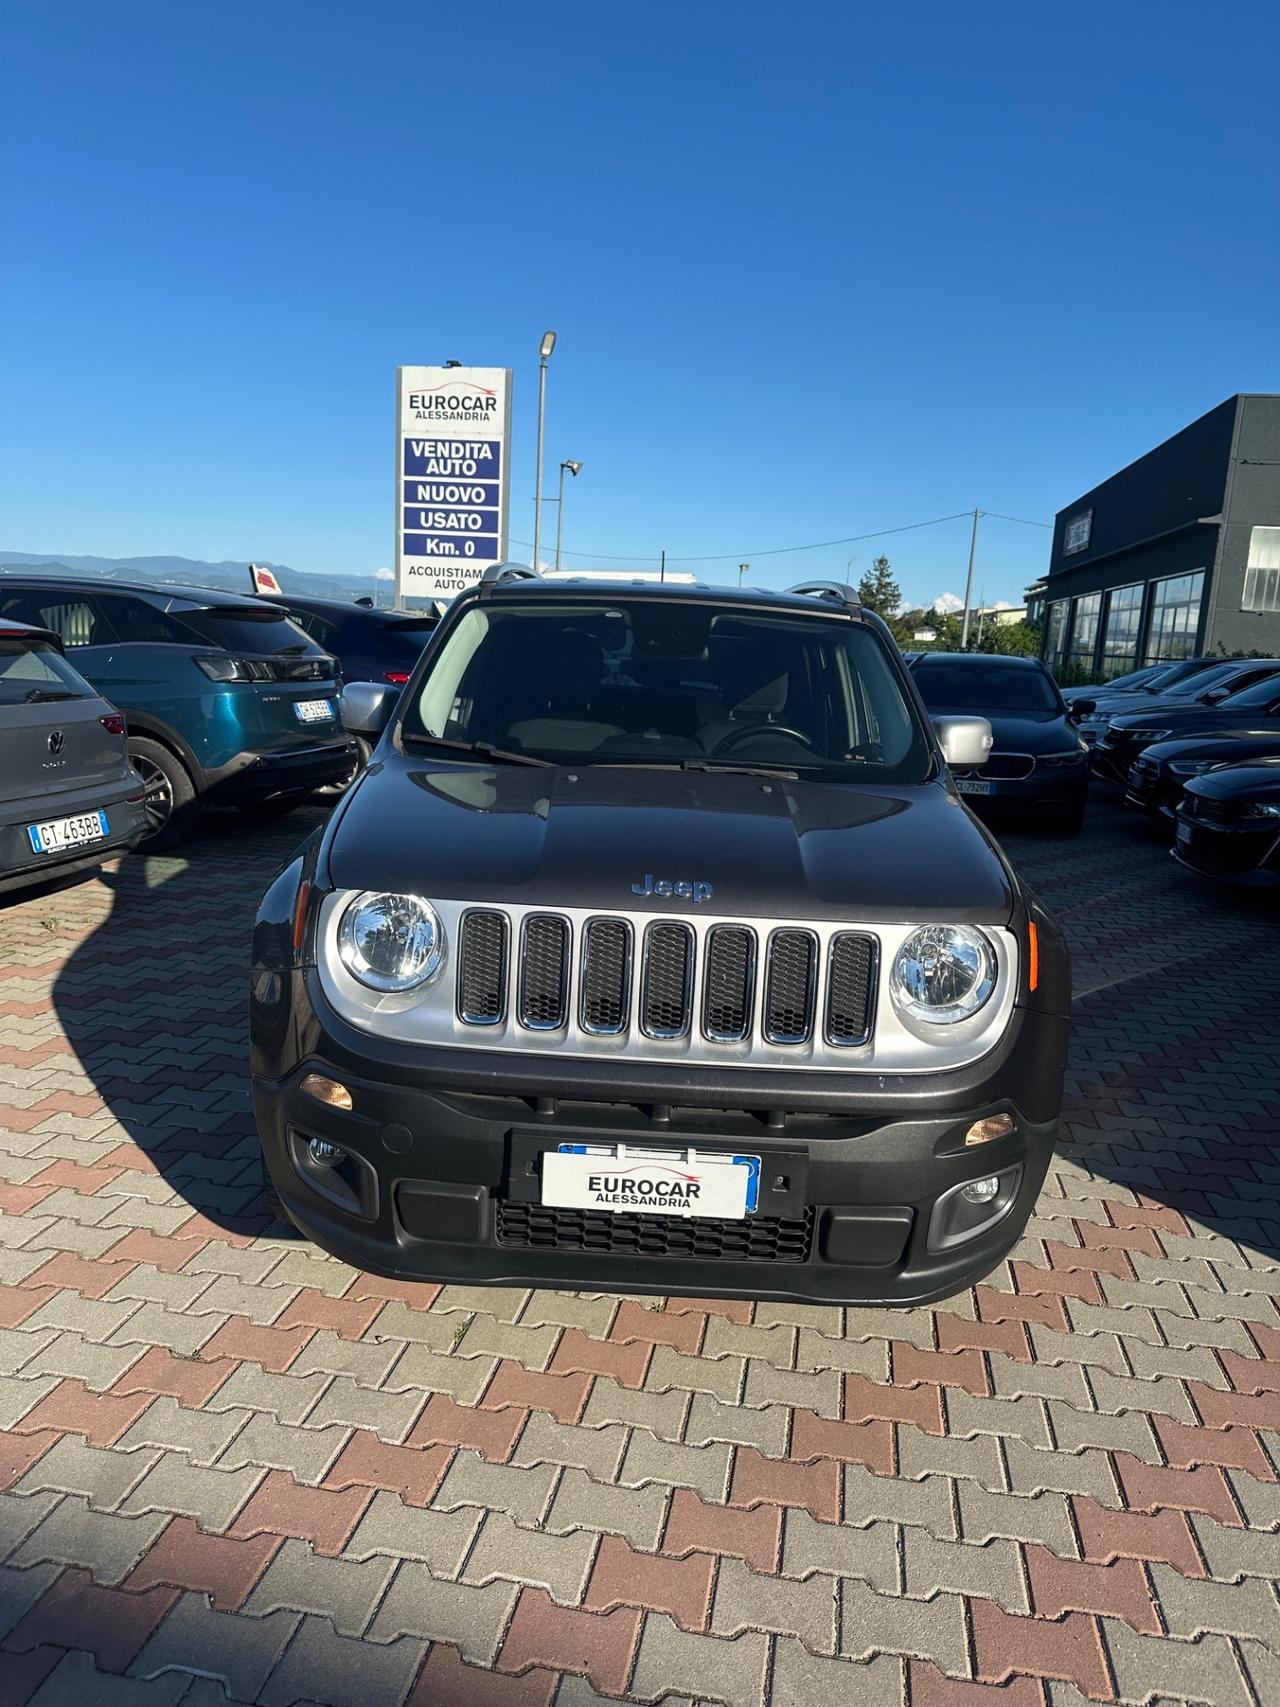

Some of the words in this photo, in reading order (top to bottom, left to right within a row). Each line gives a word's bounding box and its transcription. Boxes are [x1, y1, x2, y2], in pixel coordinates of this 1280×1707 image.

[409, 394, 497, 412] EUROCAR
[415, 410, 490, 421] ALESSANDRIA
[411, 440, 493, 460] VENDITA
[426, 458, 477, 476] AUTO
[417, 484, 486, 504] NUOVO
[420, 511, 482, 530] USATO
[426, 538, 460, 555] Km.
[464, 540, 475, 556] 0
[408, 566, 483, 579] ACQUISTIAM
[434, 579, 465, 590] AUTO
[631, 874, 713, 904] Jeep
[588, 1176, 701, 1199] EUROCAR
[595, 1193, 691, 1208] ALESSANDRIA
